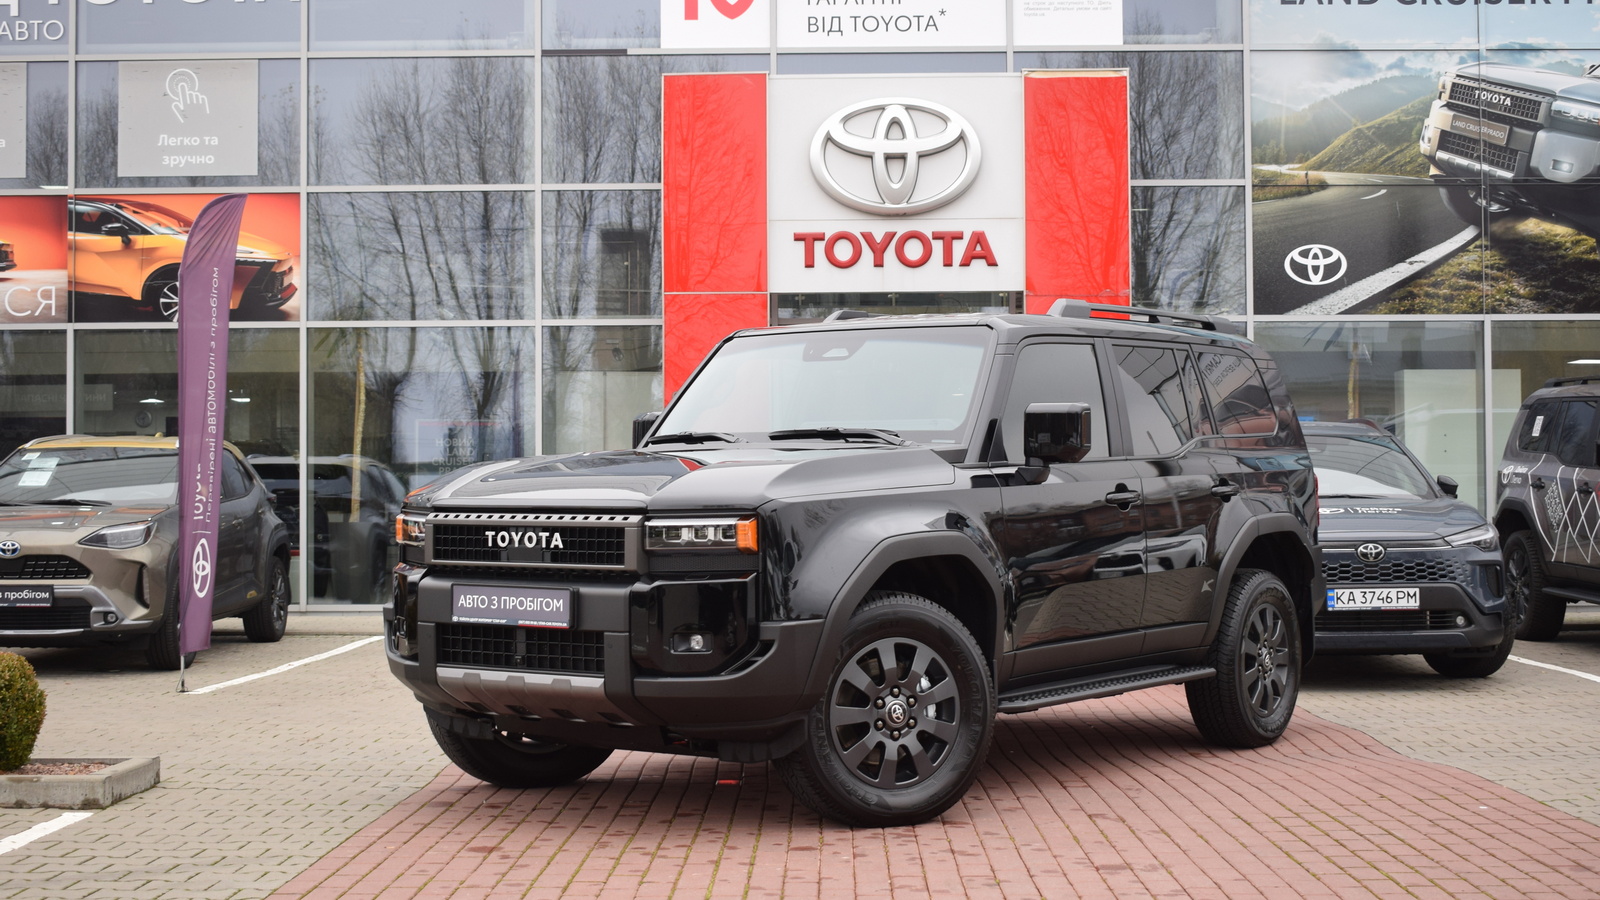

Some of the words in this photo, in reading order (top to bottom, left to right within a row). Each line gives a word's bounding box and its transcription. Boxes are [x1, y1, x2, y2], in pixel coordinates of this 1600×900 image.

[0, 19, 64, 41] АВТО
[807, 15, 844, 37] ВІД
[1474, 90, 1511, 106] TOYOTA
[1452, 120, 1466, 128] LAND
[1466, 123, 1488, 132] CRUISER
[1487, 128, 1505, 138] PRADO
[157, 134, 201, 146] Легко
[203, 136, 219, 145] та
[161, 154, 215, 168] зручно
[793, 230, 999, 270] TOYOTA
[4, 285, 57, 317] СЯ
[209, 266, 220, 337] пробігом
[446, 447, 475, 456] LAND
[485, 531, 564, 549] TOYOTA
[4, 589, 50, 601] пробігом
[458, 594, 489, 609] АВТО
[500, 596, 564, 612] ПРОБІГОМ
[1335, 591, 1357, 605] KA
[1360, 590, 1394, 605] 3746
[1396, 590, 1418, 604] PM
